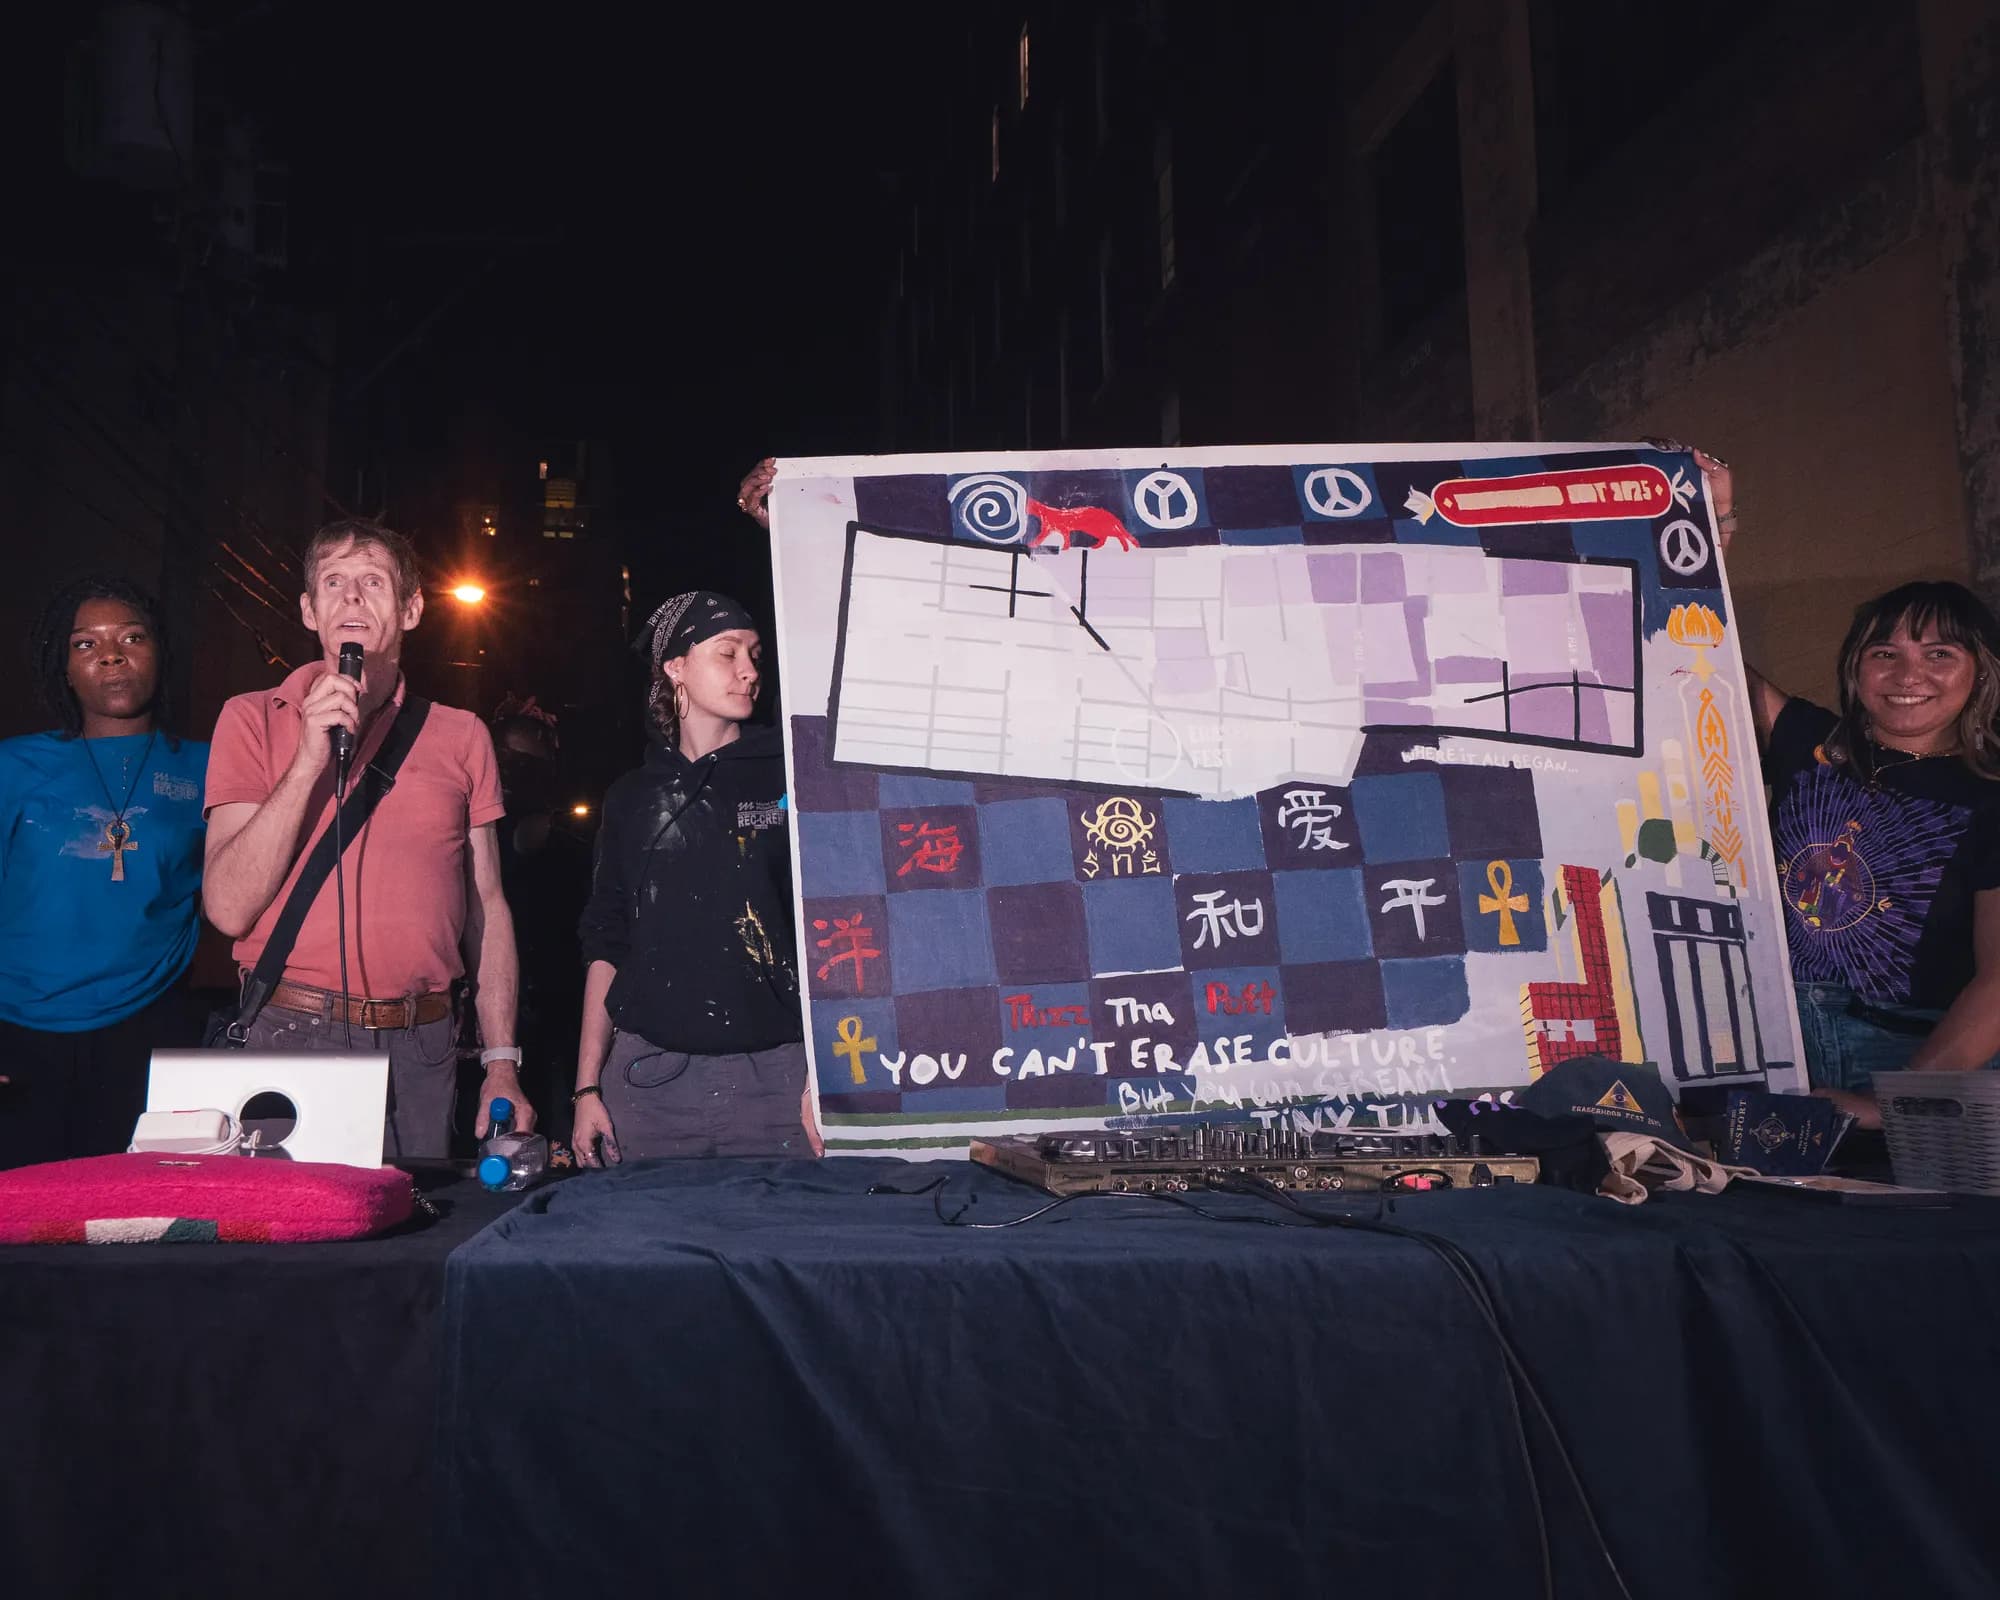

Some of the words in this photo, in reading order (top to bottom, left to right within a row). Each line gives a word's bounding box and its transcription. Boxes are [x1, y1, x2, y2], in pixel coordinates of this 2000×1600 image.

[1401, 745, 1456, 764] WHERE
[896, 821, 964, 876] 海
[1186, 889, 1264, 949] 和
[1381, 878, 1447, 942] 平
[813, 912, 881, 993] 洋
[1105, 997, 1175, 1027] Tha
[880, 1051, 967, 1085] YOU
[992, 1037, 1116, 1080] CAN'T
[1131, 1034, 1254, 1076] ERASE
[1267, 1028, 1458, 1070] CULTURE.
[1733, 1099, 1747, 1160] ASSPORT
